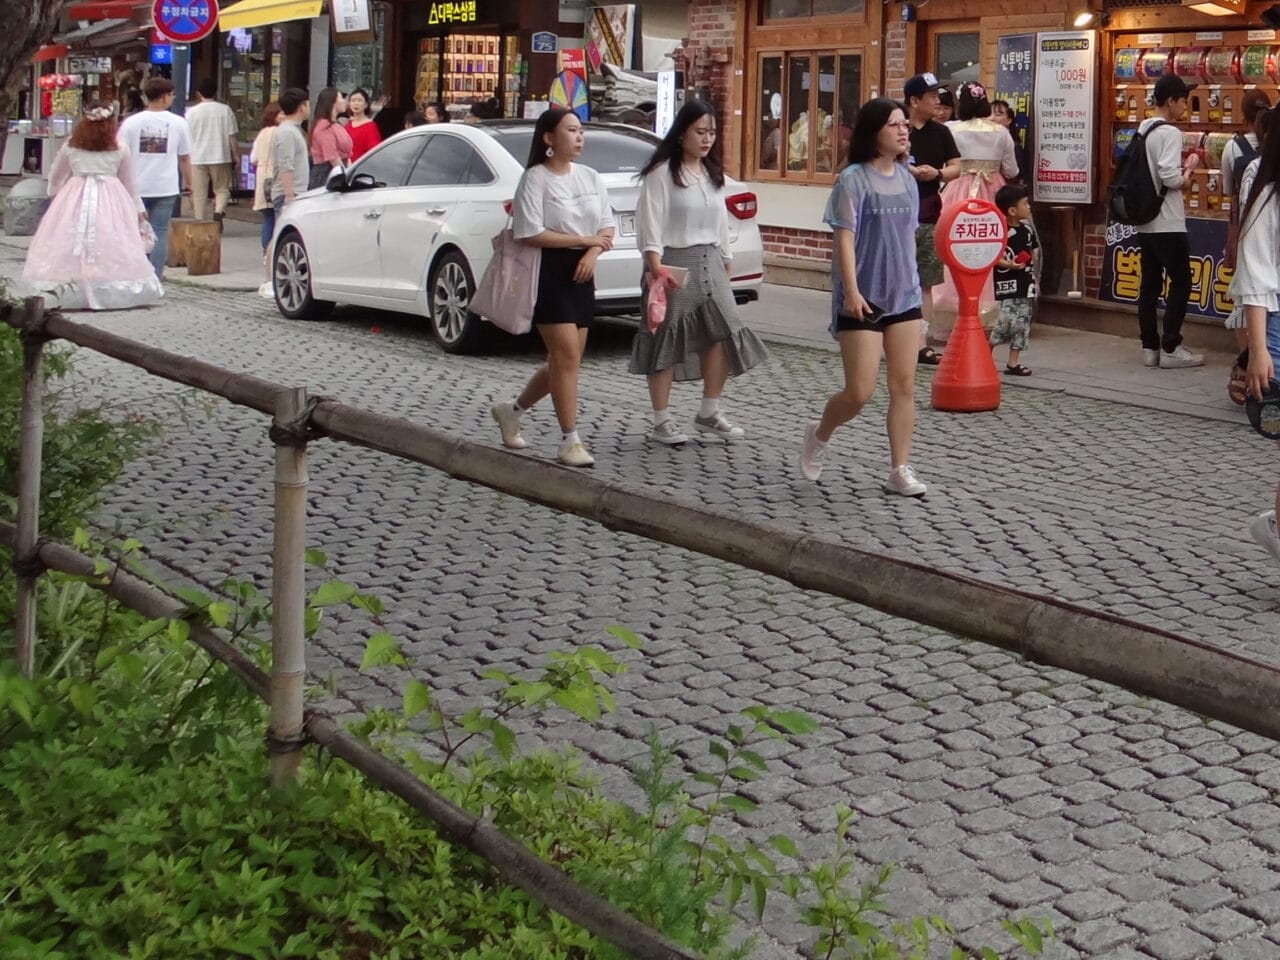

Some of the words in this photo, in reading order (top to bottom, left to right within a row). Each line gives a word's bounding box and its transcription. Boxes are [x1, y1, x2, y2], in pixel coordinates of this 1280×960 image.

[162, 5, 209, 17] 주정차금지
[537, 42, 553, 51] 75
[1000, 50, 1031, 71] 신통방통
[1055, 68, 1086, 83] 1,000원
[956, 223, 999, 238] 주차금지
